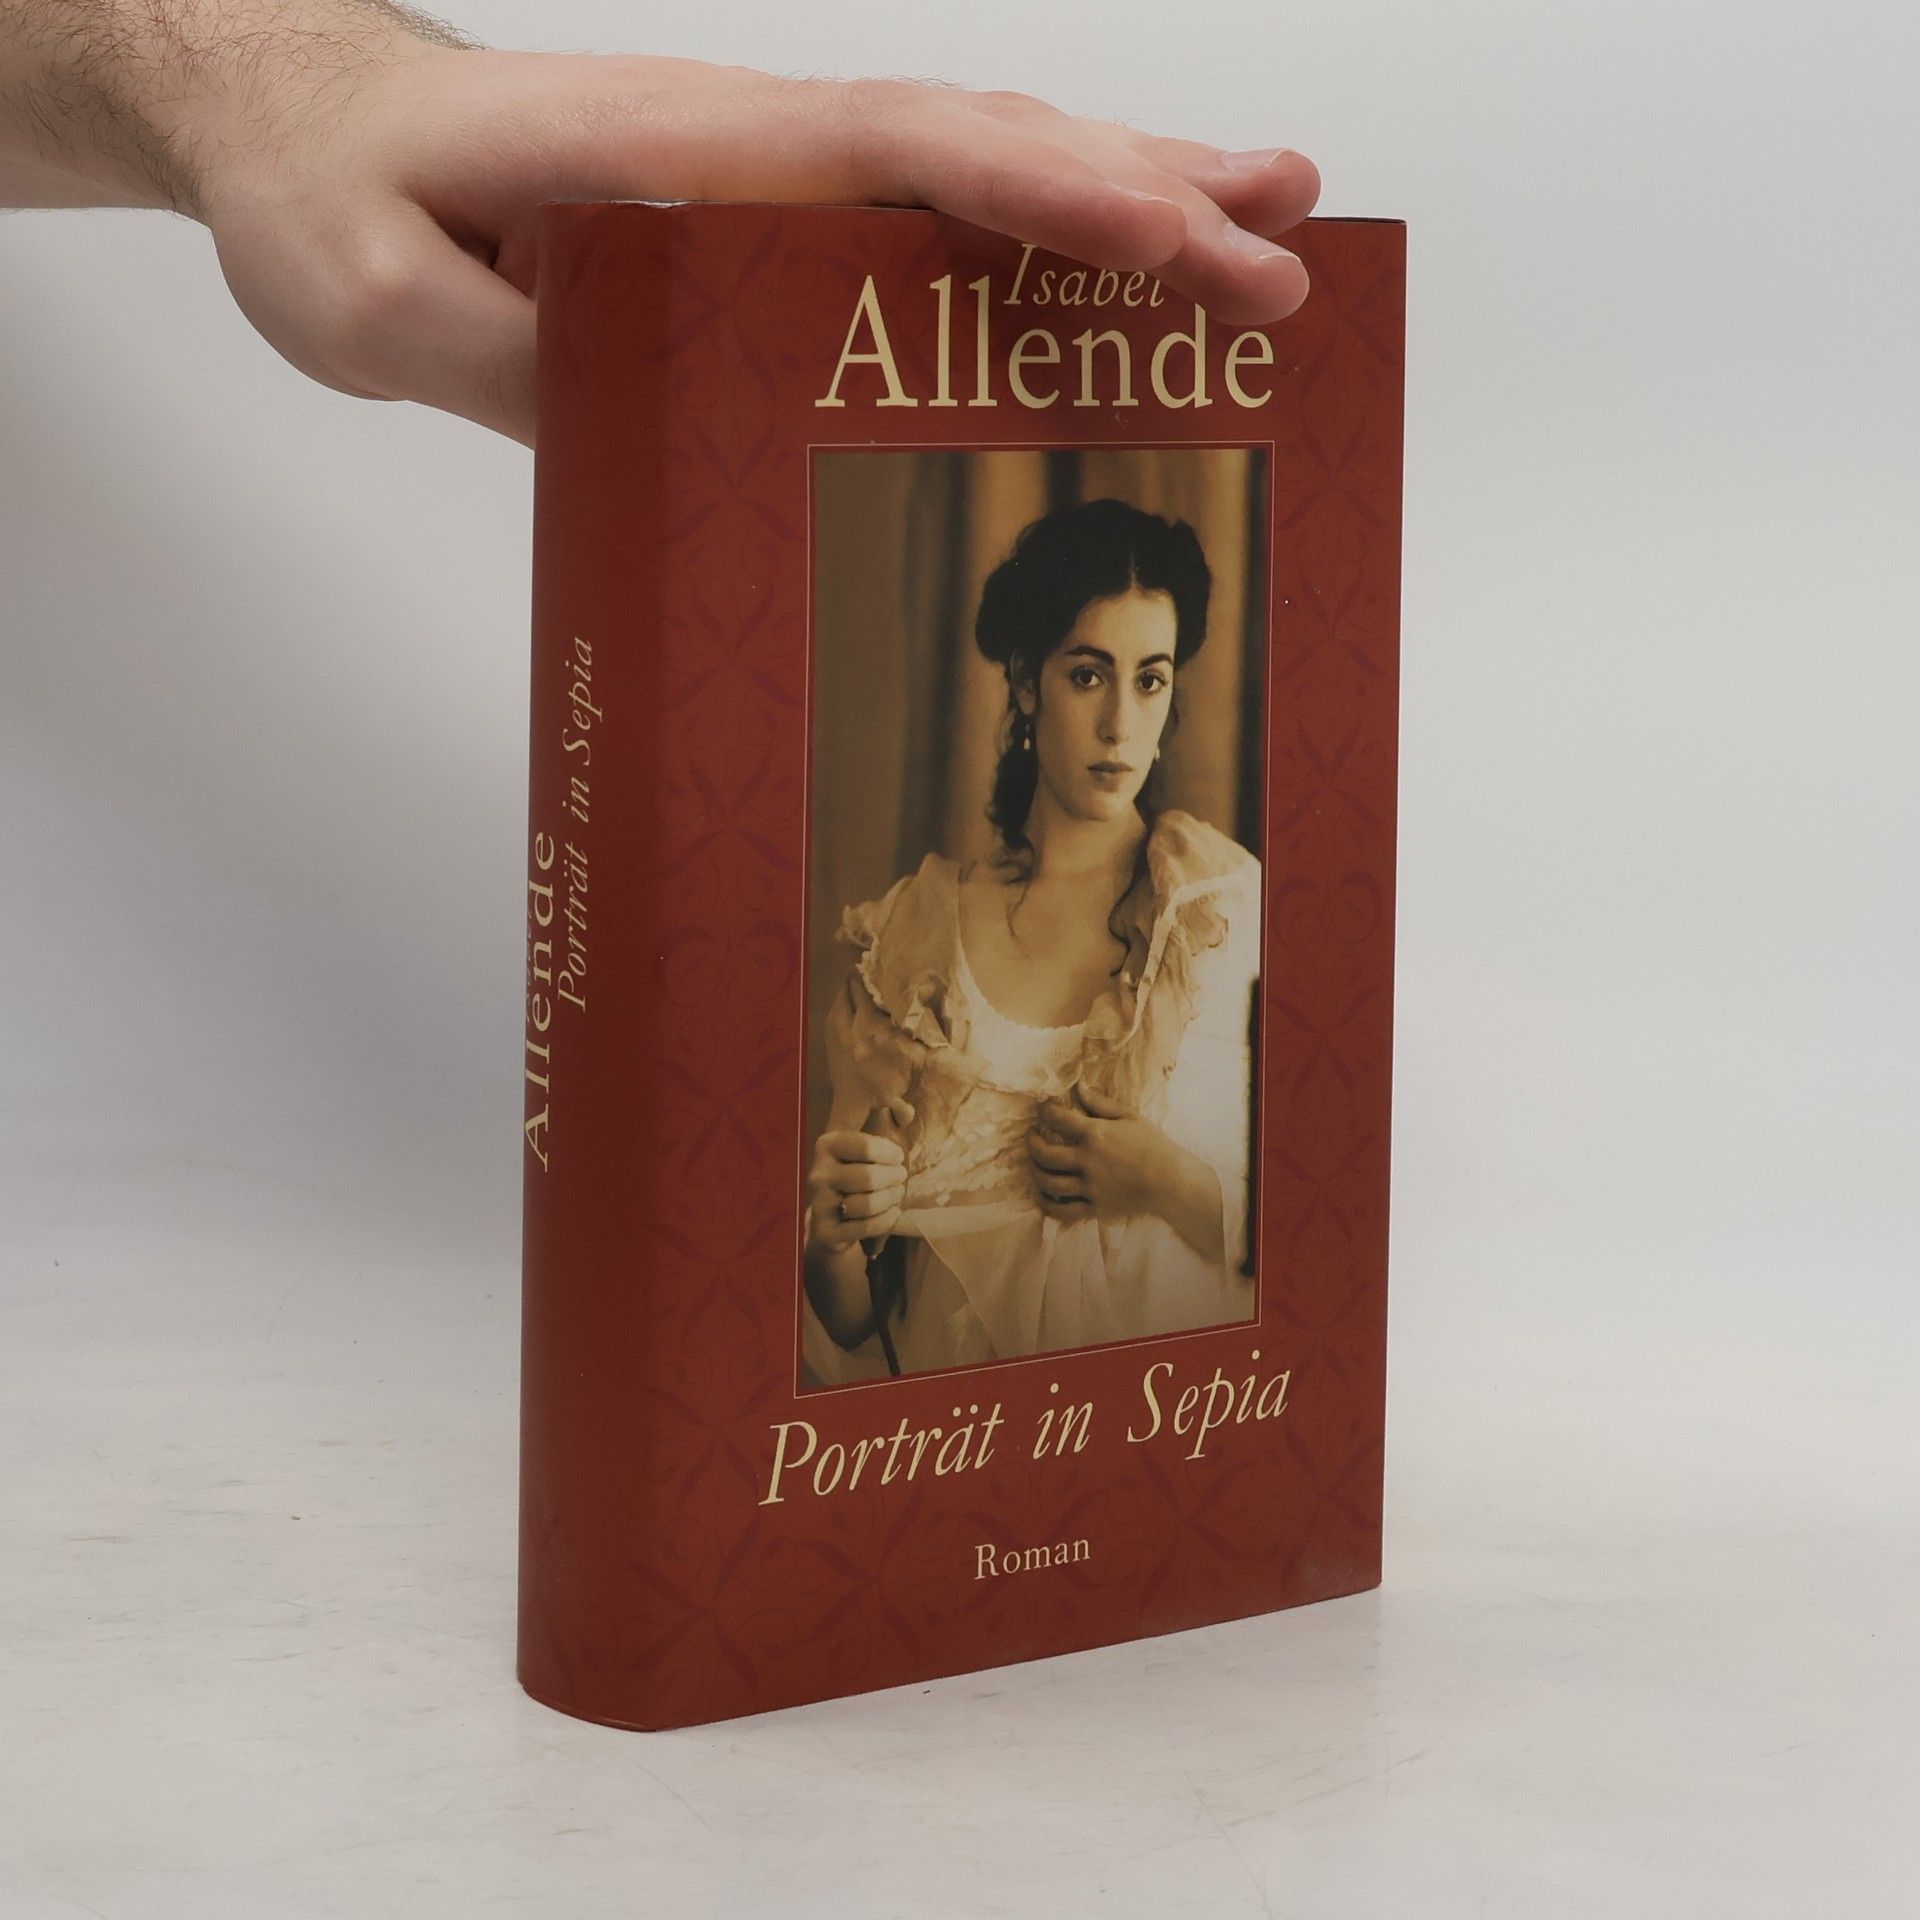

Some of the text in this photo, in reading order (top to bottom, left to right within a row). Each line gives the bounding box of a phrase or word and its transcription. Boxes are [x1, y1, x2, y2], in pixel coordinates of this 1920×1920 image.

[814, 274, 1275, 409] Allende
[557, 636, 603, 1013] Porträt in Sepia
[524, 831, 555, 1173] Allende
[758, 1349, 1291, 1506] Porträt in Sepia
[974, 1538, 1091, 1580] Roman
